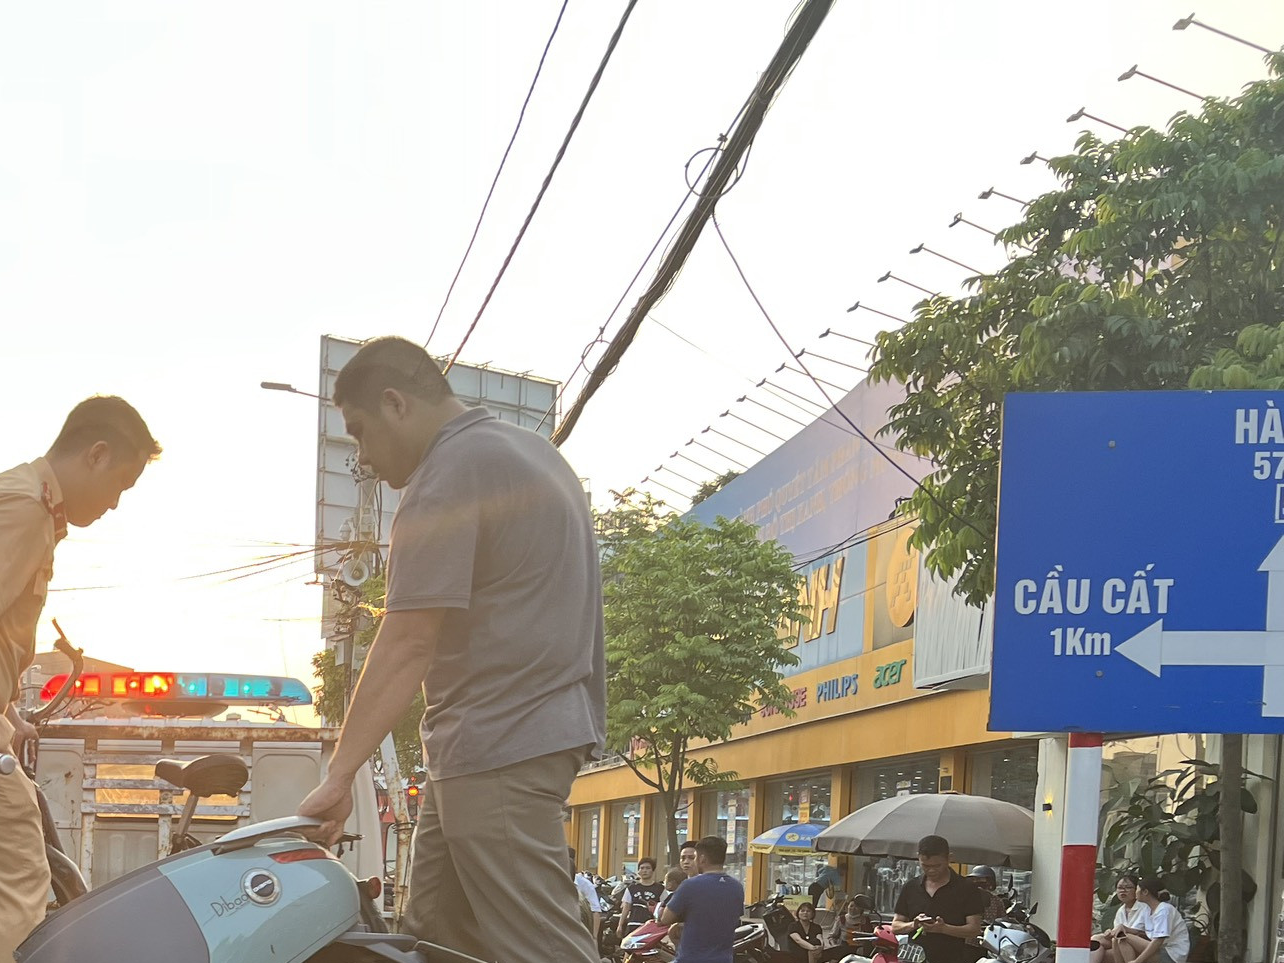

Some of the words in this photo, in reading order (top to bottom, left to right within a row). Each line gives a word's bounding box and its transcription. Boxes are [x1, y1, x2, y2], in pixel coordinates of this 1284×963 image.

[1014, 564, 1091, 615] CẦU
[1102, 563, 1175, 615] CẤT
[1050, 627, 1111, 656] 1Km
[817, 673, 859, 704] PHILIPS
[873, 659, 907, 689] acer
